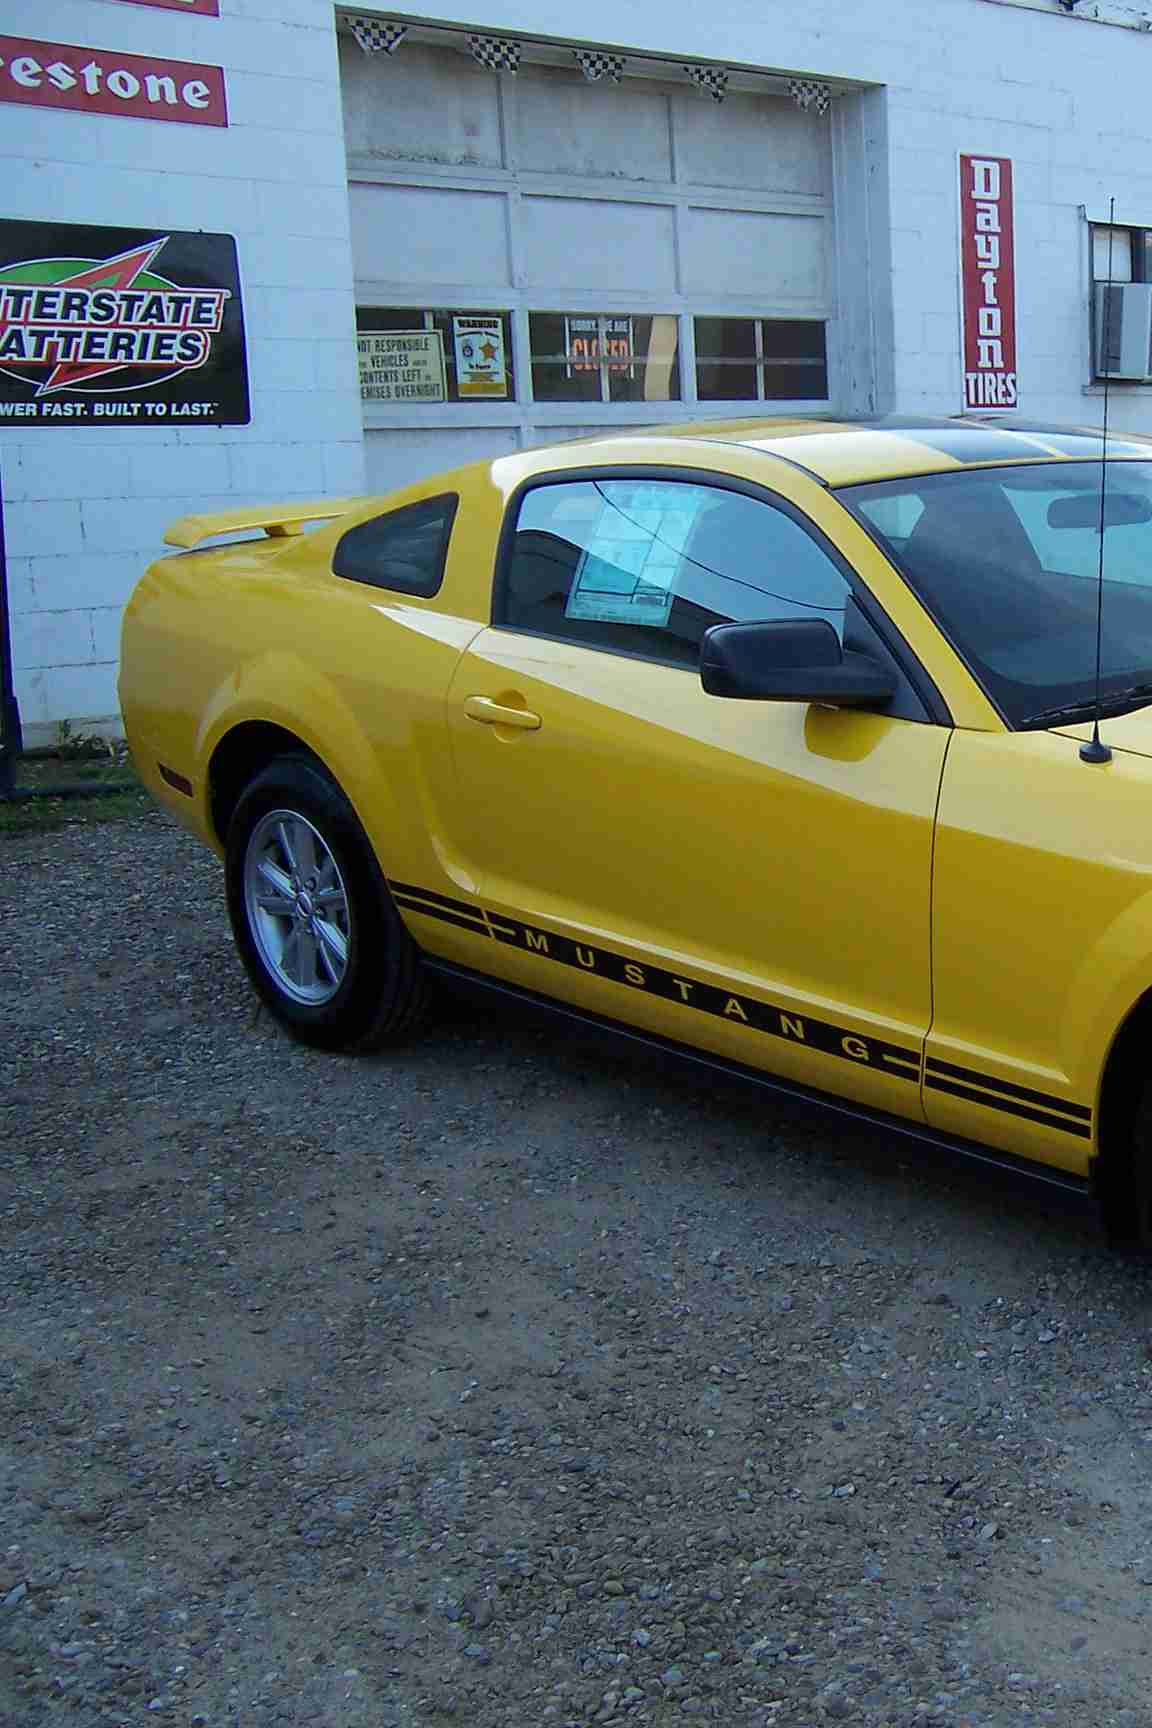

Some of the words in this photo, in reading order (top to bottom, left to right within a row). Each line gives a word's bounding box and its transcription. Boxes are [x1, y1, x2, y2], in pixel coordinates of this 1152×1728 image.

[0, 57, 210, 108] estone
[971, 159, 1004, 369] Dayton
[0, 288, 220, 327] TERSTATE
[375, 337, 430, 352] RESPONSIBLE
[572, 336, 628, 370] CLOED
[370, 353, 409, 368] VEHICLES
[402, 369, 421, 382] LEFT
[394, 384, 441, 398] OVERNIGHT
[965, 373, 1017, 404] TIRES
[42, 403, 88, 416] FAST.
[93, 403, 142, 416] BUILT
[145, 403, 167, 416] TO
[525, 928, 870, 1062] MUSTANG
